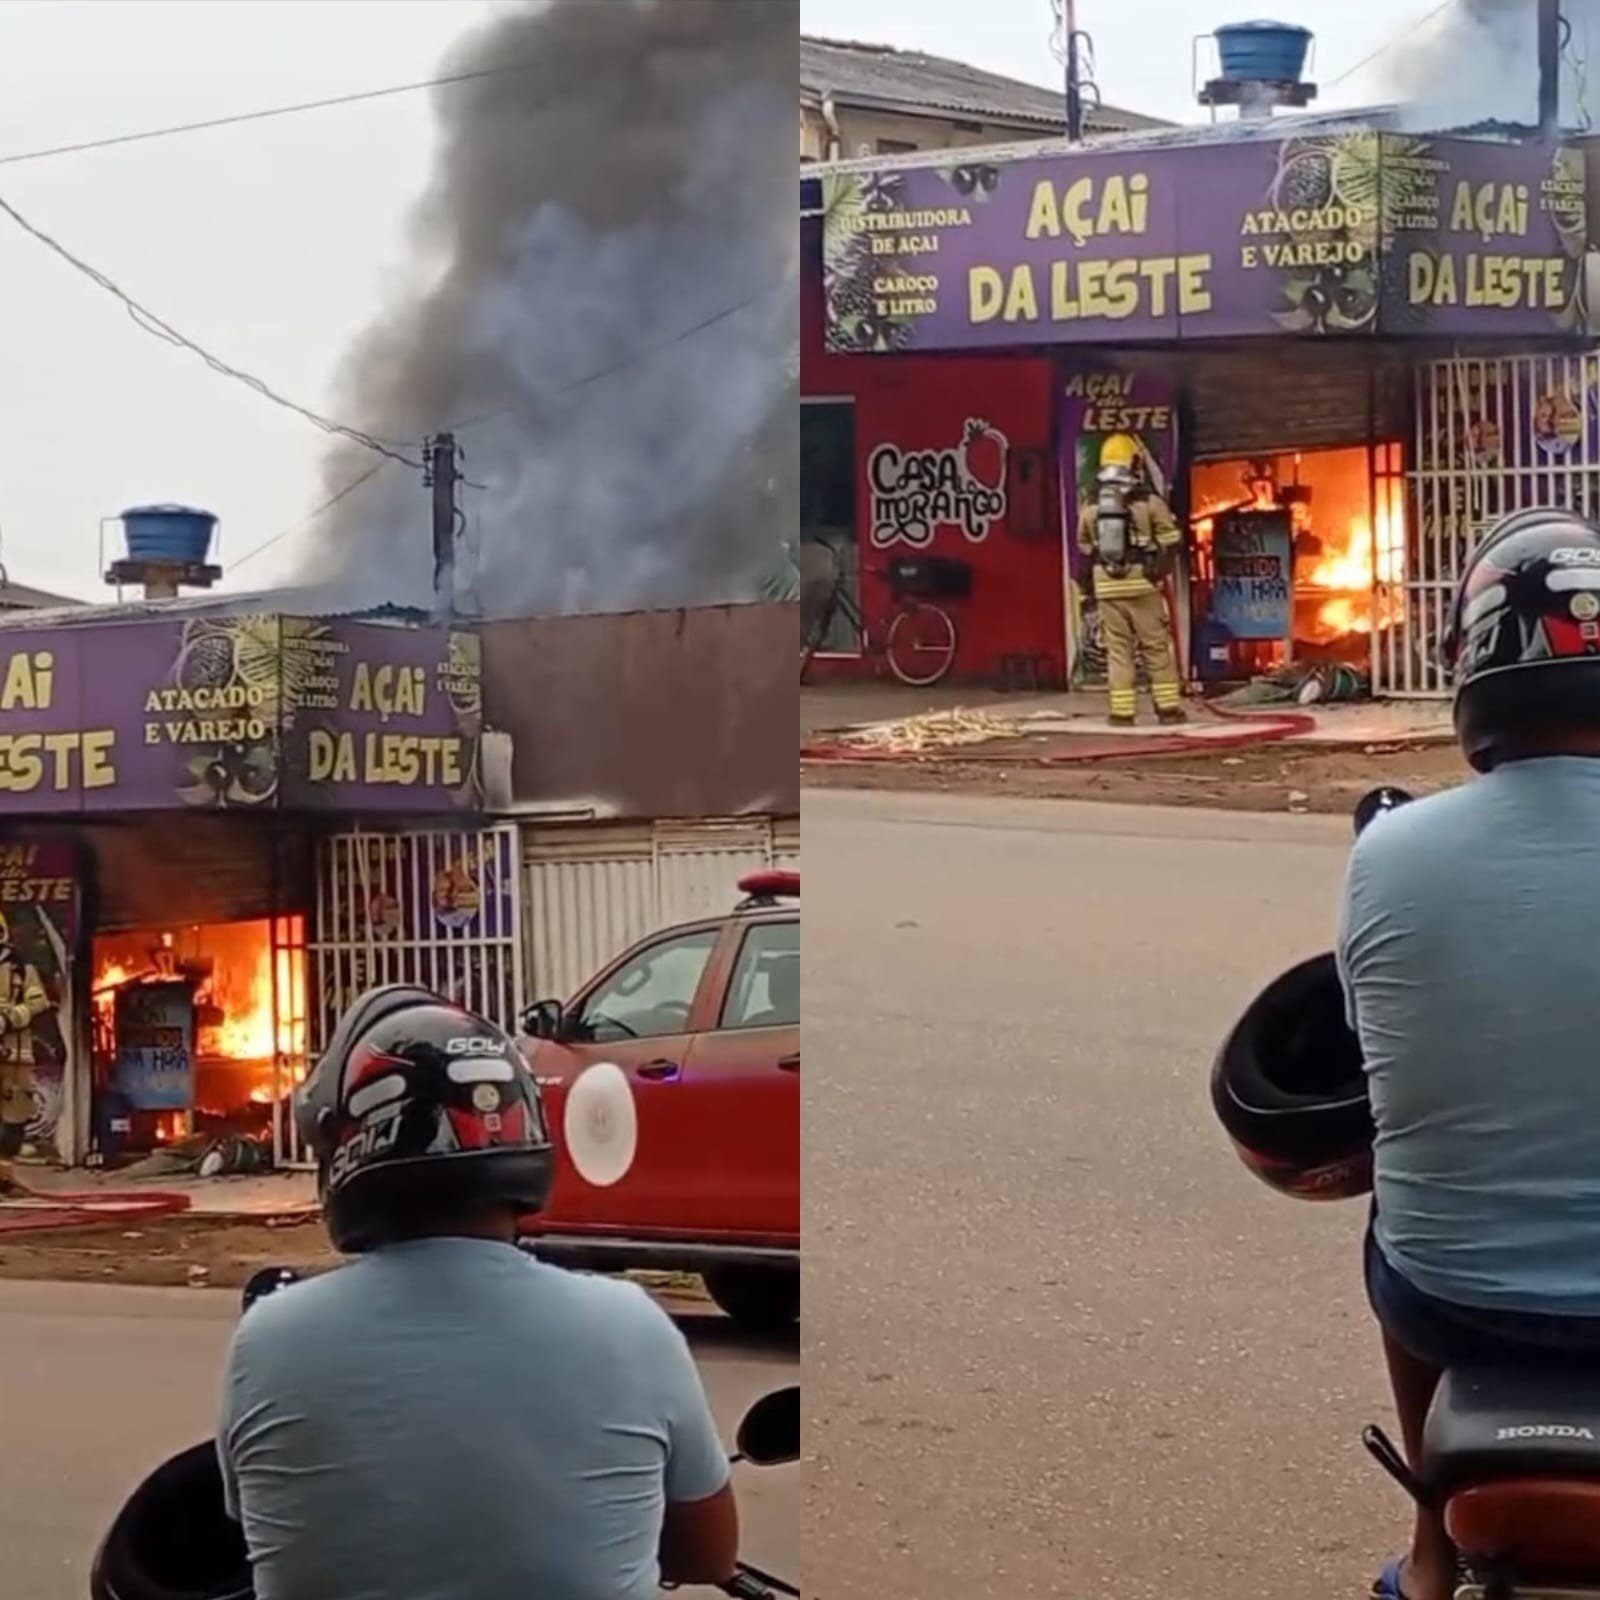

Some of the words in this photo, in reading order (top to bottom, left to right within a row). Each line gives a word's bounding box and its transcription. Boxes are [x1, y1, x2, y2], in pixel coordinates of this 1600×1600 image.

[840, 209, 971, 231] DISTRIBUIDORA
[1241, 207, 1363, 235] ATACADO
[872, 238, 895, 254] DE
[898, 236, 938, 256] AÇAI
[1241, 247, 1257, 268] E
[1264, 241, 1364, 267] VAREJO
[873, 276, 939, 295] CAROÇO
[968, 263, 1038, 324] DA
[1051, 254, 1212, 321] LESTE
[1409, 252, 1457, 305] DA
[1465, 254, 1565, 308] LESTE
[876, 300, 887, 316] E
[890, 298, 937, 314] LITRO
[1066, 372, 1135, 402] AÇAI
[1082, 405, 1170, 430] LESTE
[1549, 547, 1600, 563] GO
[144, 686, 263, 712] ATACADO
[144, 723, 160, 743] E
[165, 719, 265, 743] VAREJO
[309, 730, 357, 782] DA
[365, 732, 461, 786] LESTE
[1496, 1424, 1594, 1440] HONDA
